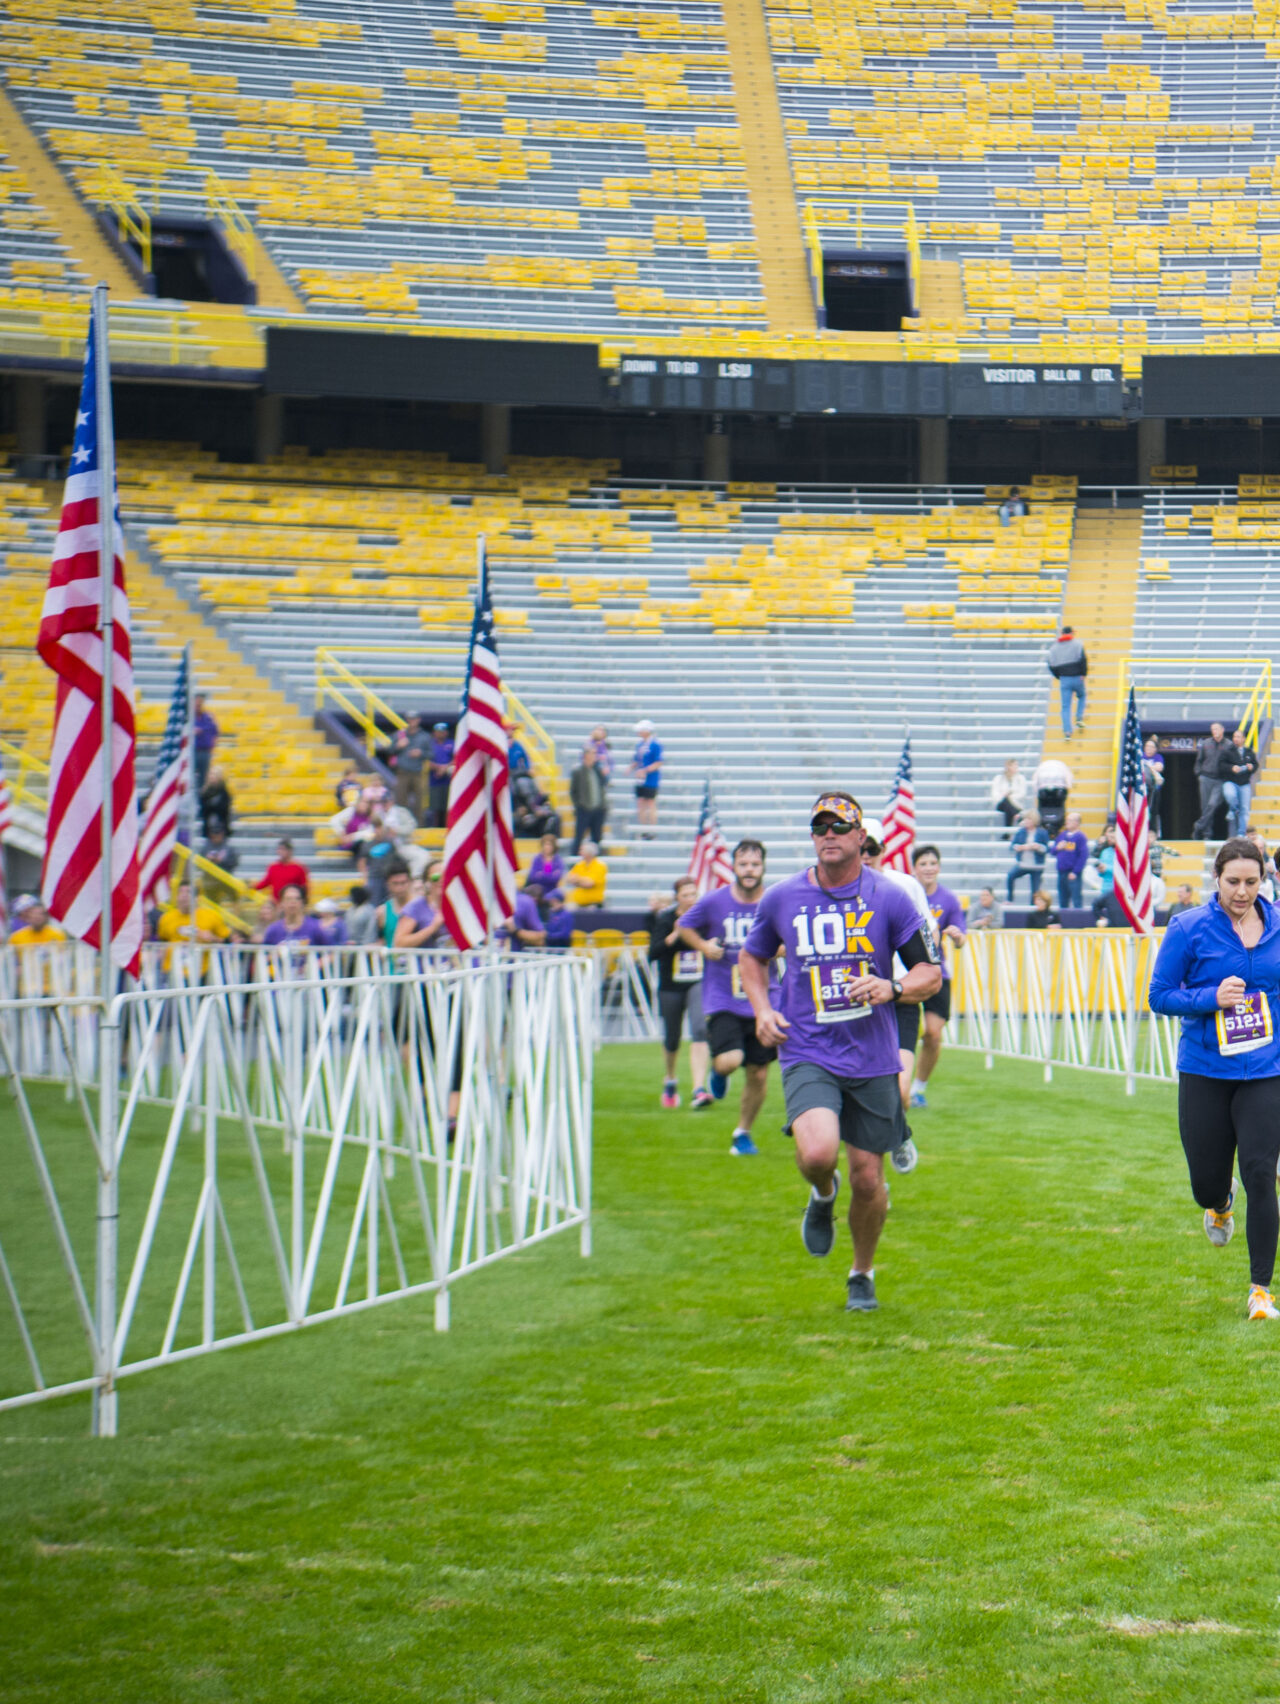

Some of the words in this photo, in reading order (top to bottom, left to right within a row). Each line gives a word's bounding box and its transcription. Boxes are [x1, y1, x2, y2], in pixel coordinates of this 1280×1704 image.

[719, 363, 753, 378] LSU
[983, 367, 1036, 383] VISITOR
[1043, 369, 1066, 381] BALL
[1171, 736, 1194, 749] 402
[800, 903, 867, 914] TIGER
[722, 916, 756, 944] 10
[793, 910, 876, 957] 10K
[846, 927, 866, 937] LSU
[821, 983, 852, 1000] 317
[1224, 1013, 1264, 1031] 5121
